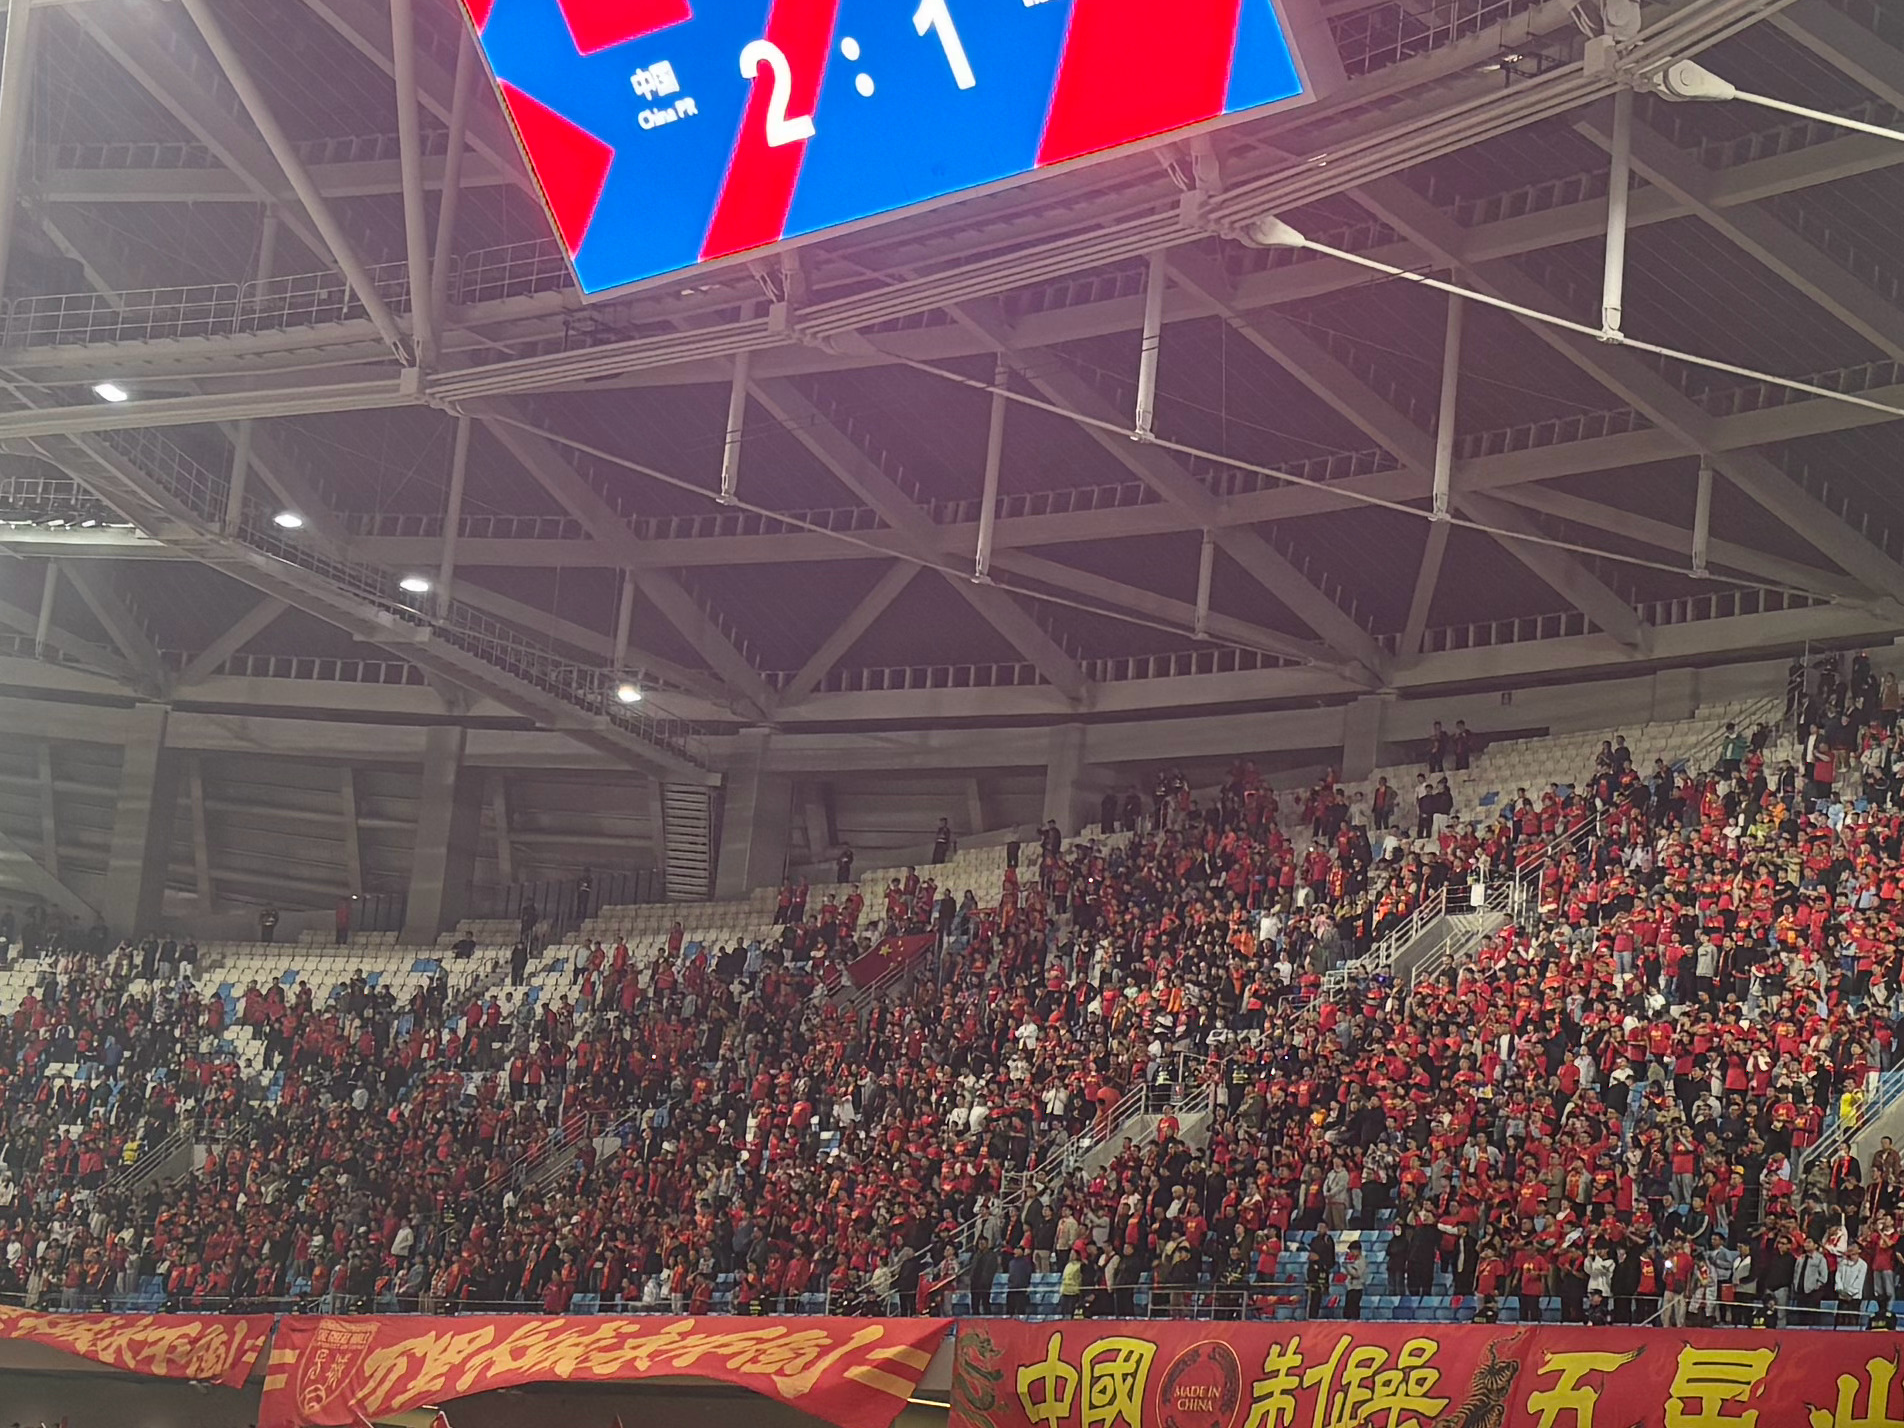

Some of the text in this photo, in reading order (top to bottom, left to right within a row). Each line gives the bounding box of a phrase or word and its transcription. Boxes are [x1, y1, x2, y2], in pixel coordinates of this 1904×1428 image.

[630, 60, 680, 100] 中国
[739, 39, 816, 147] 2
[638, 106, 678, 131] China
[1174, 1384, 1221, 1399] MADE IN
[1177, 1398, 1213, 1413] CHINA
